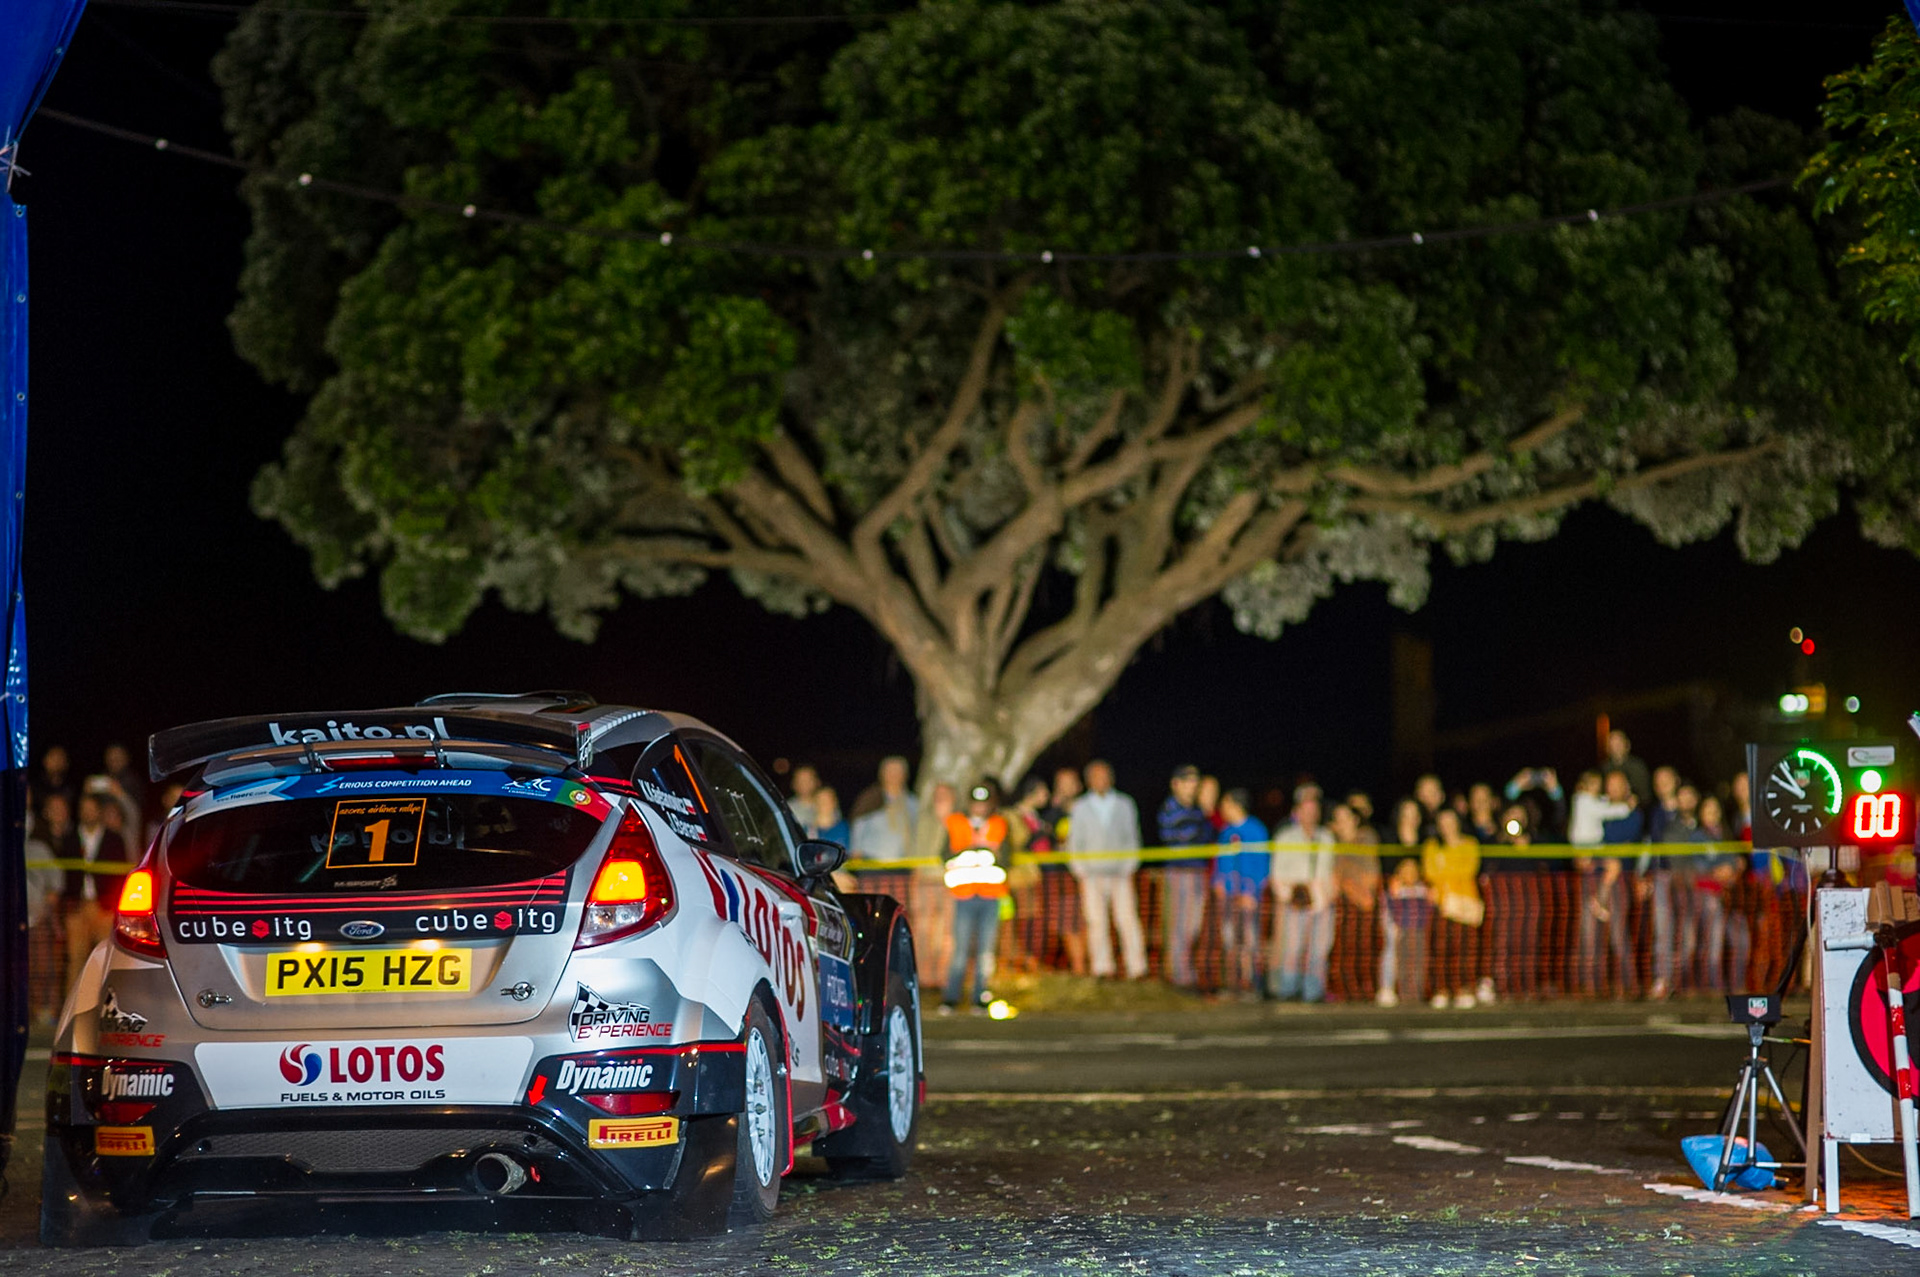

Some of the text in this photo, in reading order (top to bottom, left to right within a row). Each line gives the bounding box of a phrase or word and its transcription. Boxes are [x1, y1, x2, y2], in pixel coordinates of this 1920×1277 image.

[268, 717, 451, 746] kaito.pl
[374, 779, 442, 789] COMPETITION
[442, 779, 472, 787] AHEAD
[367, 804, 397, 814] airlines
[1854, 793, 1901, 838] 00
[364, 819, 391, 862] 1
[179, 916, 246, 938] cube
[349, 924, 374, 936] Ford
[415, 909, 488, 932] cube
[277, 955, 462, 990] PX15 HZG
[580, 1009, 650, 1027] DRIVING
[329, 1044, 446, 1084] LOTOS
[102, 1067, 175, 1100] Dynamic
[556, 1060, 654, 1095] Dynamic
[280, 1089, 446, 1102] FUELS & MOTOR OILS
[599, 1121, 672, 1143] PIRELLI
